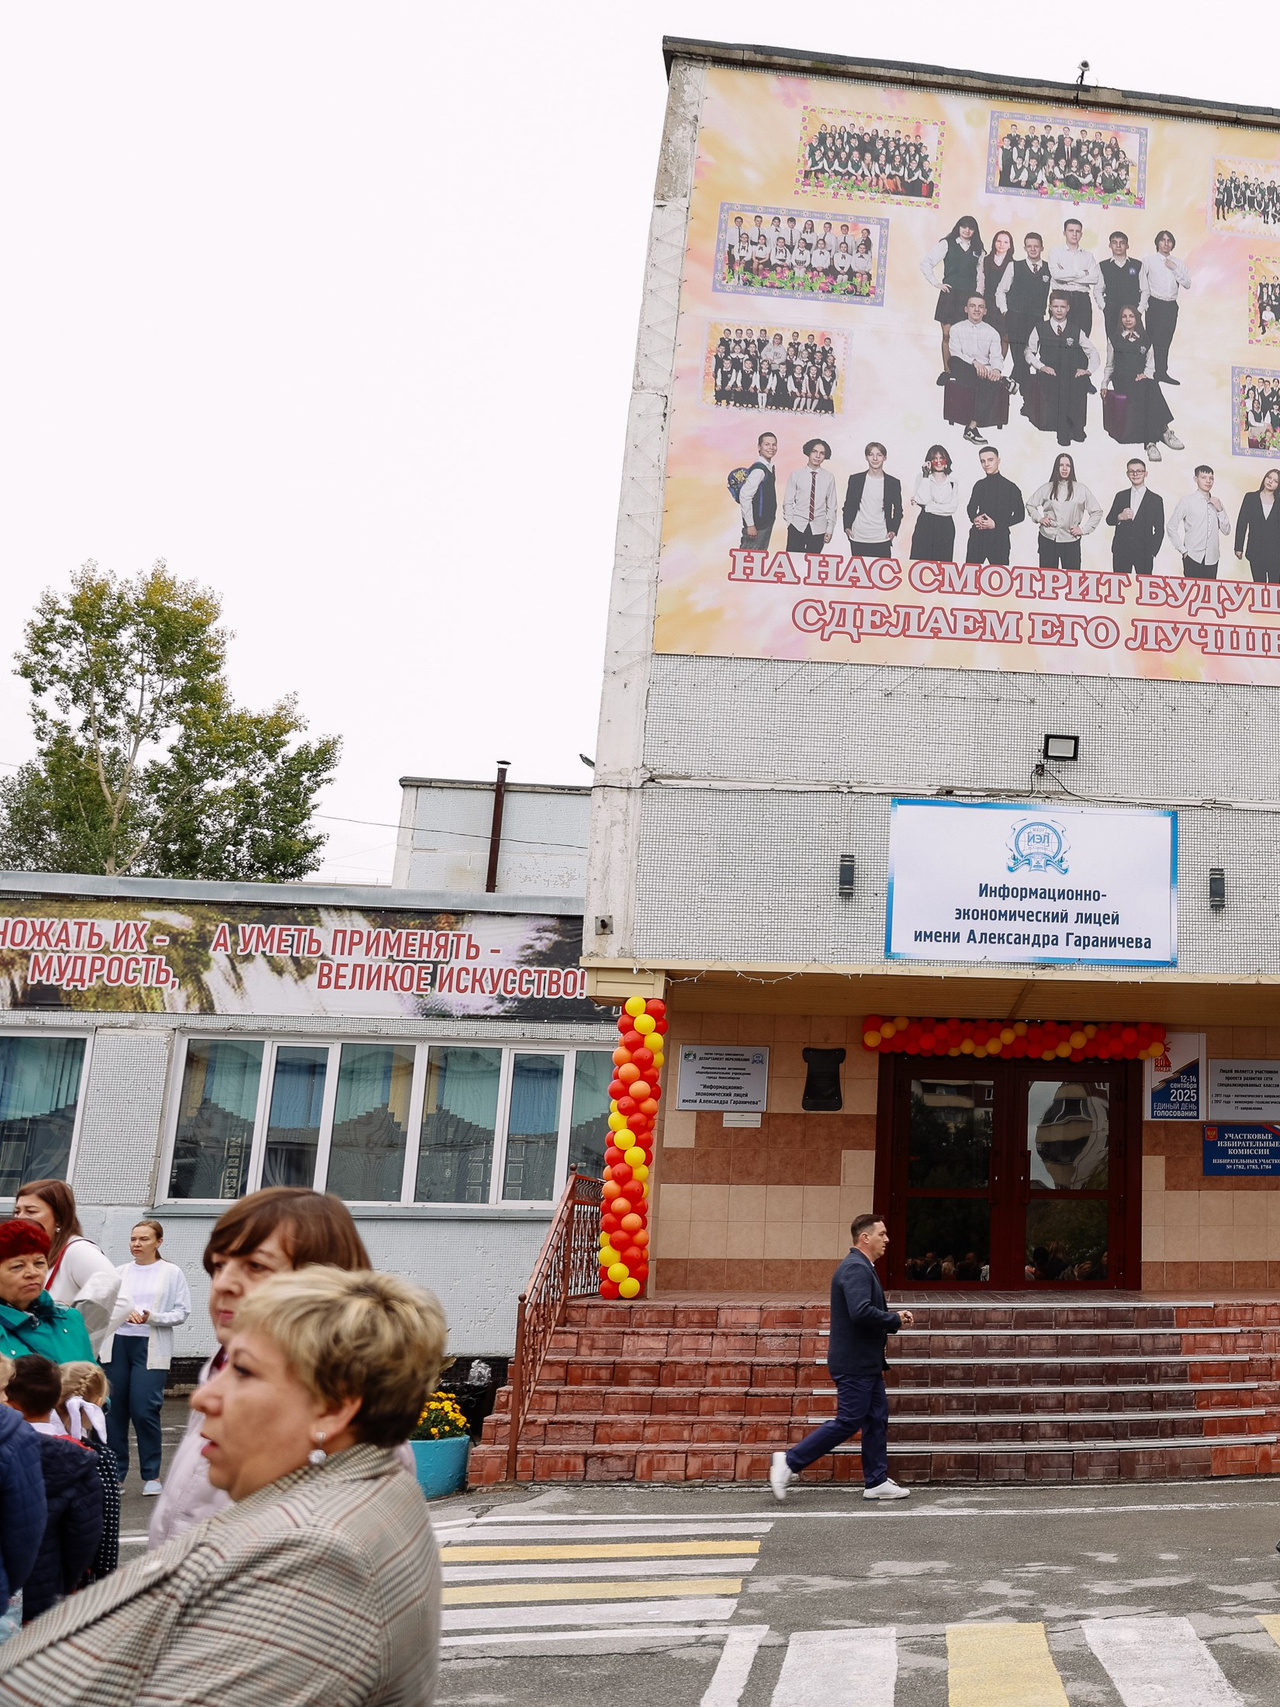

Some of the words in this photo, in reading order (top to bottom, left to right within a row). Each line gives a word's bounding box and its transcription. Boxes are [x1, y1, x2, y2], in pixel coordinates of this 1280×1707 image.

[729, 549, 798, 585] НА
[805, 554, 901, 590] НАС
[909, 560, 1132, 605] СМОТРИТ
[792, 599, 1022, 645] СДЕЛАЕМ
[1029, 613, 1121, 649] ЕГО
[1028, 834, 1050, 844] ИЭЛ
[978, 883, 1107, 904] Информационно-
[955, 907, 1069, 924] экономический
[1074, 910, 1120, 927] лицей
[112, 922, 148, 951] ИХ
[212, 926, 229, 952] А
[240, 926, 322, 955] УМЕТЬ
[331, 928, 480, 960] ПРИМЕНЯТЬ
[914, 929, 960, 944] имени
[967, 929, 1059, 948] Александра
[1066, 932, 1152, 950] Гараничева
[29, 954, 179, 990] МУДРОСТЬ,
[317, 962, 431, 993] ВЕЛИКОЕ
[438, 966, 587, 998] ИСКУССТВО!
[1180, 1075, 1196, 1083] 12-14
[1154, 1101, 1179, 1110] ЕДИНЫЙ
[1180, 1103, 1197, 1111] ДЕНЬ
[1170, 1090, 1197, 1102] 2025
